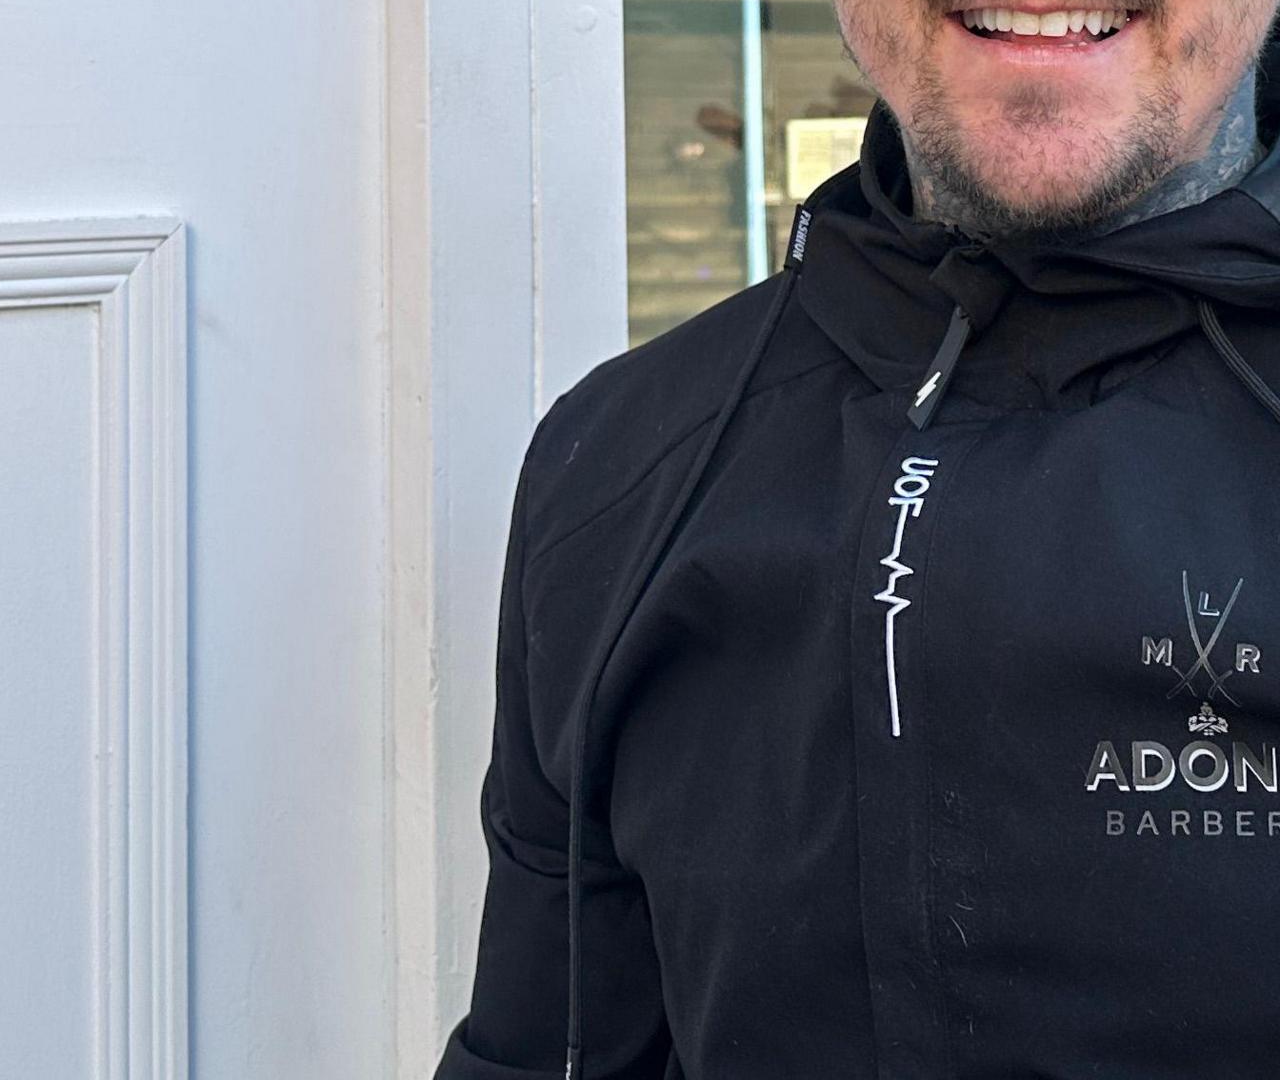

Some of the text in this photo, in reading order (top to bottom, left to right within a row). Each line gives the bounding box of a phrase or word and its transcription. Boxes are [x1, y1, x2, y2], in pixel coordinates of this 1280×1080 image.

[791, 209, 812, 262] FASHION
[1197, 591, 1220, 617] L
[1141, 636, 1261, 674] M R
